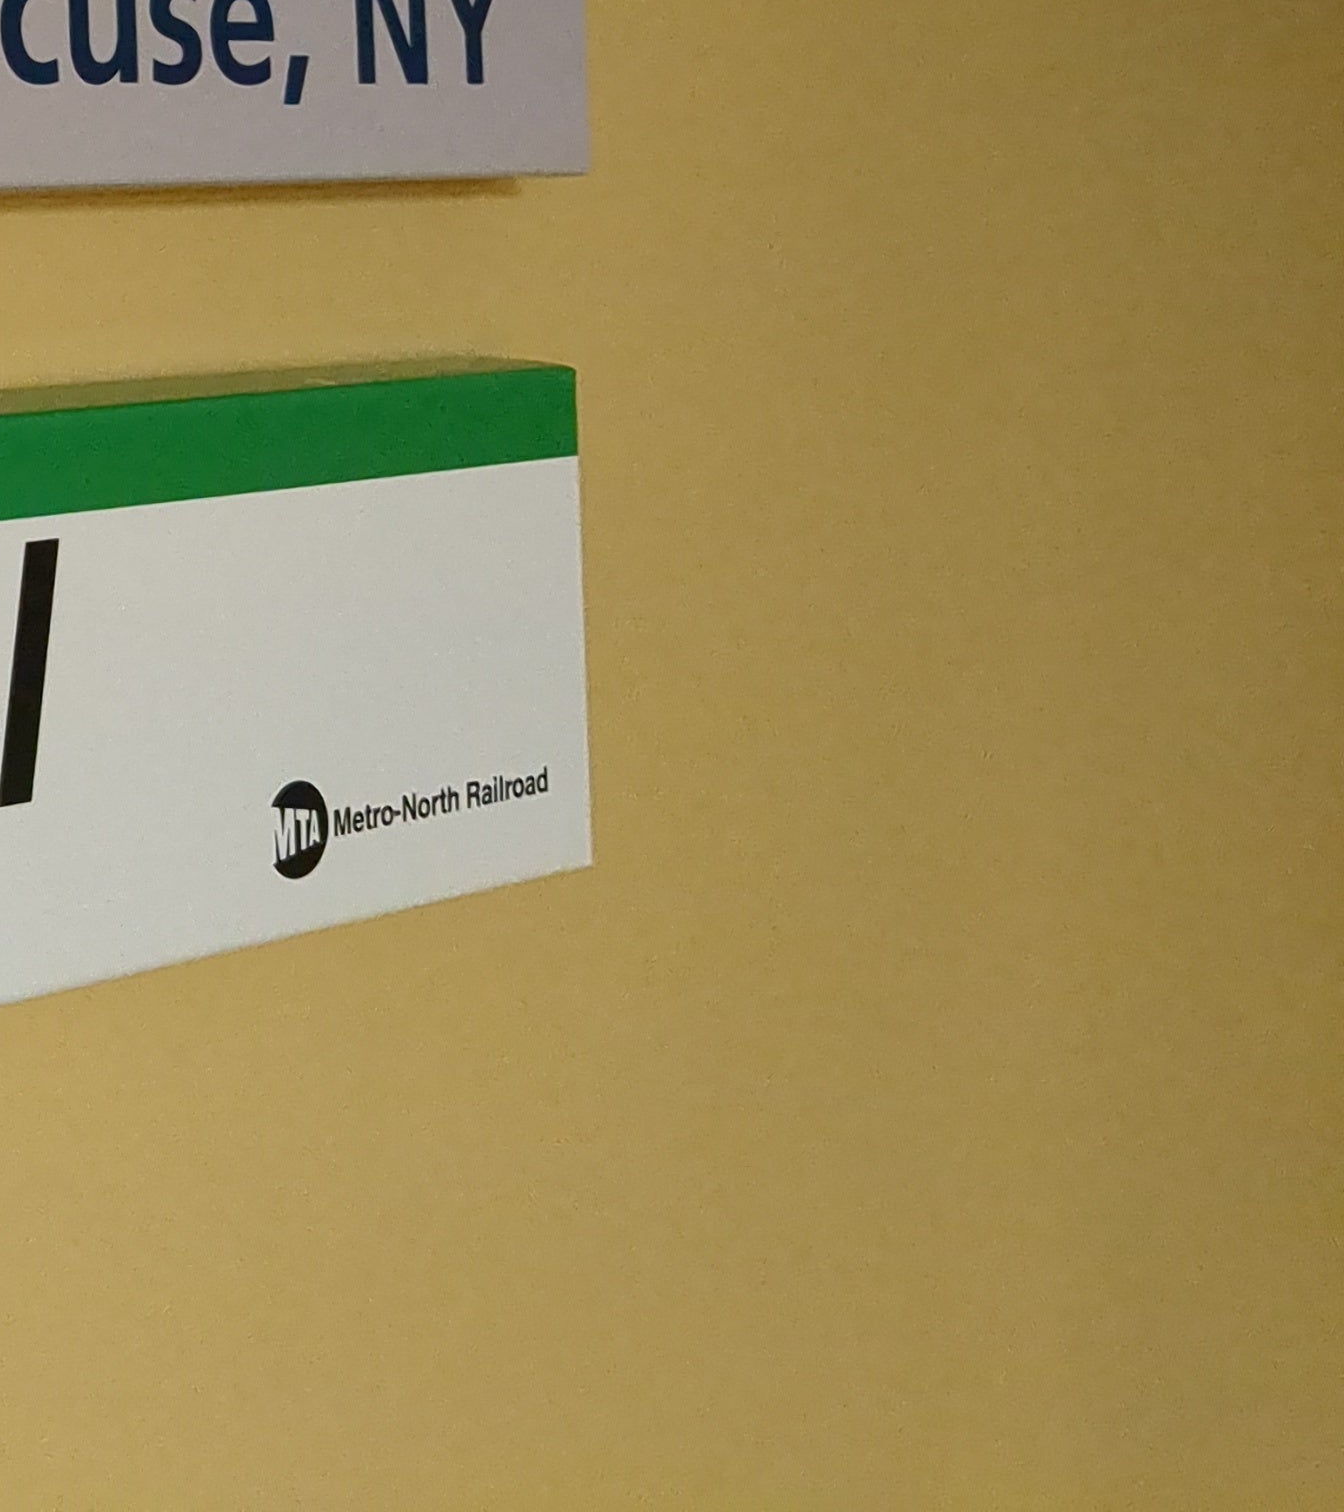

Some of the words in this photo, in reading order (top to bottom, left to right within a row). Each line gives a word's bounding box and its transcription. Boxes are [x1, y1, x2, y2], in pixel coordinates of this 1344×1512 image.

[271, 805, 323, 864] MTA
[332, 785, 461, 838] Metro-North
[465, 765, 550, 810] Railroad
